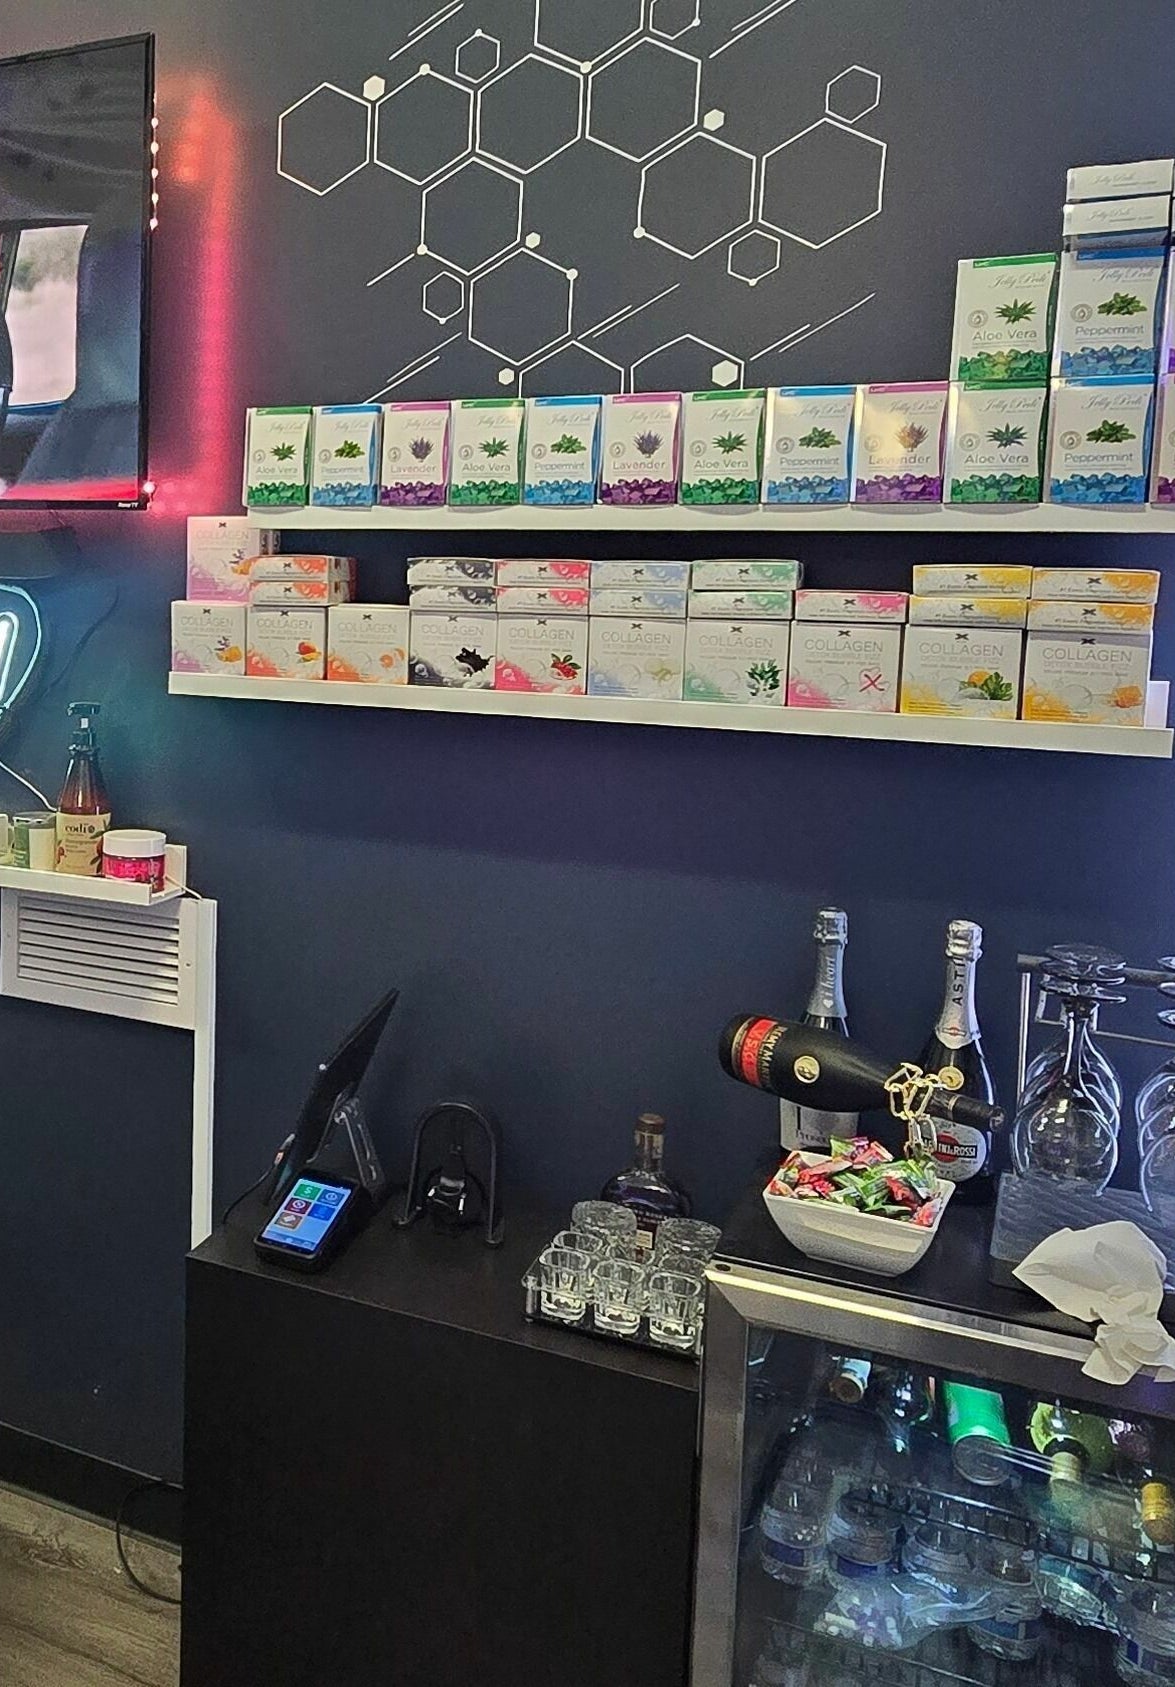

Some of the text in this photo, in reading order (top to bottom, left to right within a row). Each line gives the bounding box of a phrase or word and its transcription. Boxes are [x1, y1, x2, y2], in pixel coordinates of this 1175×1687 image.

[972, 329, 1037, 341] Aloe Vera
[1075, 325, 1145, 337] Peppermint
[694, 458, 749, 469] Aloe Vera
[780, 456, 840, 469] Peppermint
[964, 452, 1029, 464] Aloe Vera
[1064, 451, 1134, 464] Peppermint
[255, 465, 298, 475] Aloe Vera
[321, 465, 363, 475] Peppermint
[390, 464, 436, 473] Lavender
[462, 462, 511, 472] Aloe Vera
[534, 461, 585, 472] Peppermint
[612, 460, 666, 470] Lavender
[181, 615, 234, 628] COLLAGEN
[256, 618, 313, 630] COLLAGEN
[338, 622, 397, 634] COLLAGEN
[421, 624, 484, 636] COLLAGEN
[508, 627, 575, 640] COLLAGEN
[601, 631, 671, 644] COLLAGEN
[699, 635, 773, 649] COLLAGEN
[804, 639, 883, 653] COLLAGEN
[919, 642, 1004, 657] COLLAGEN
[1042, 647, 1132, 663] COLLAGEN
[954, 1147, 976, 1157] ROSSI
